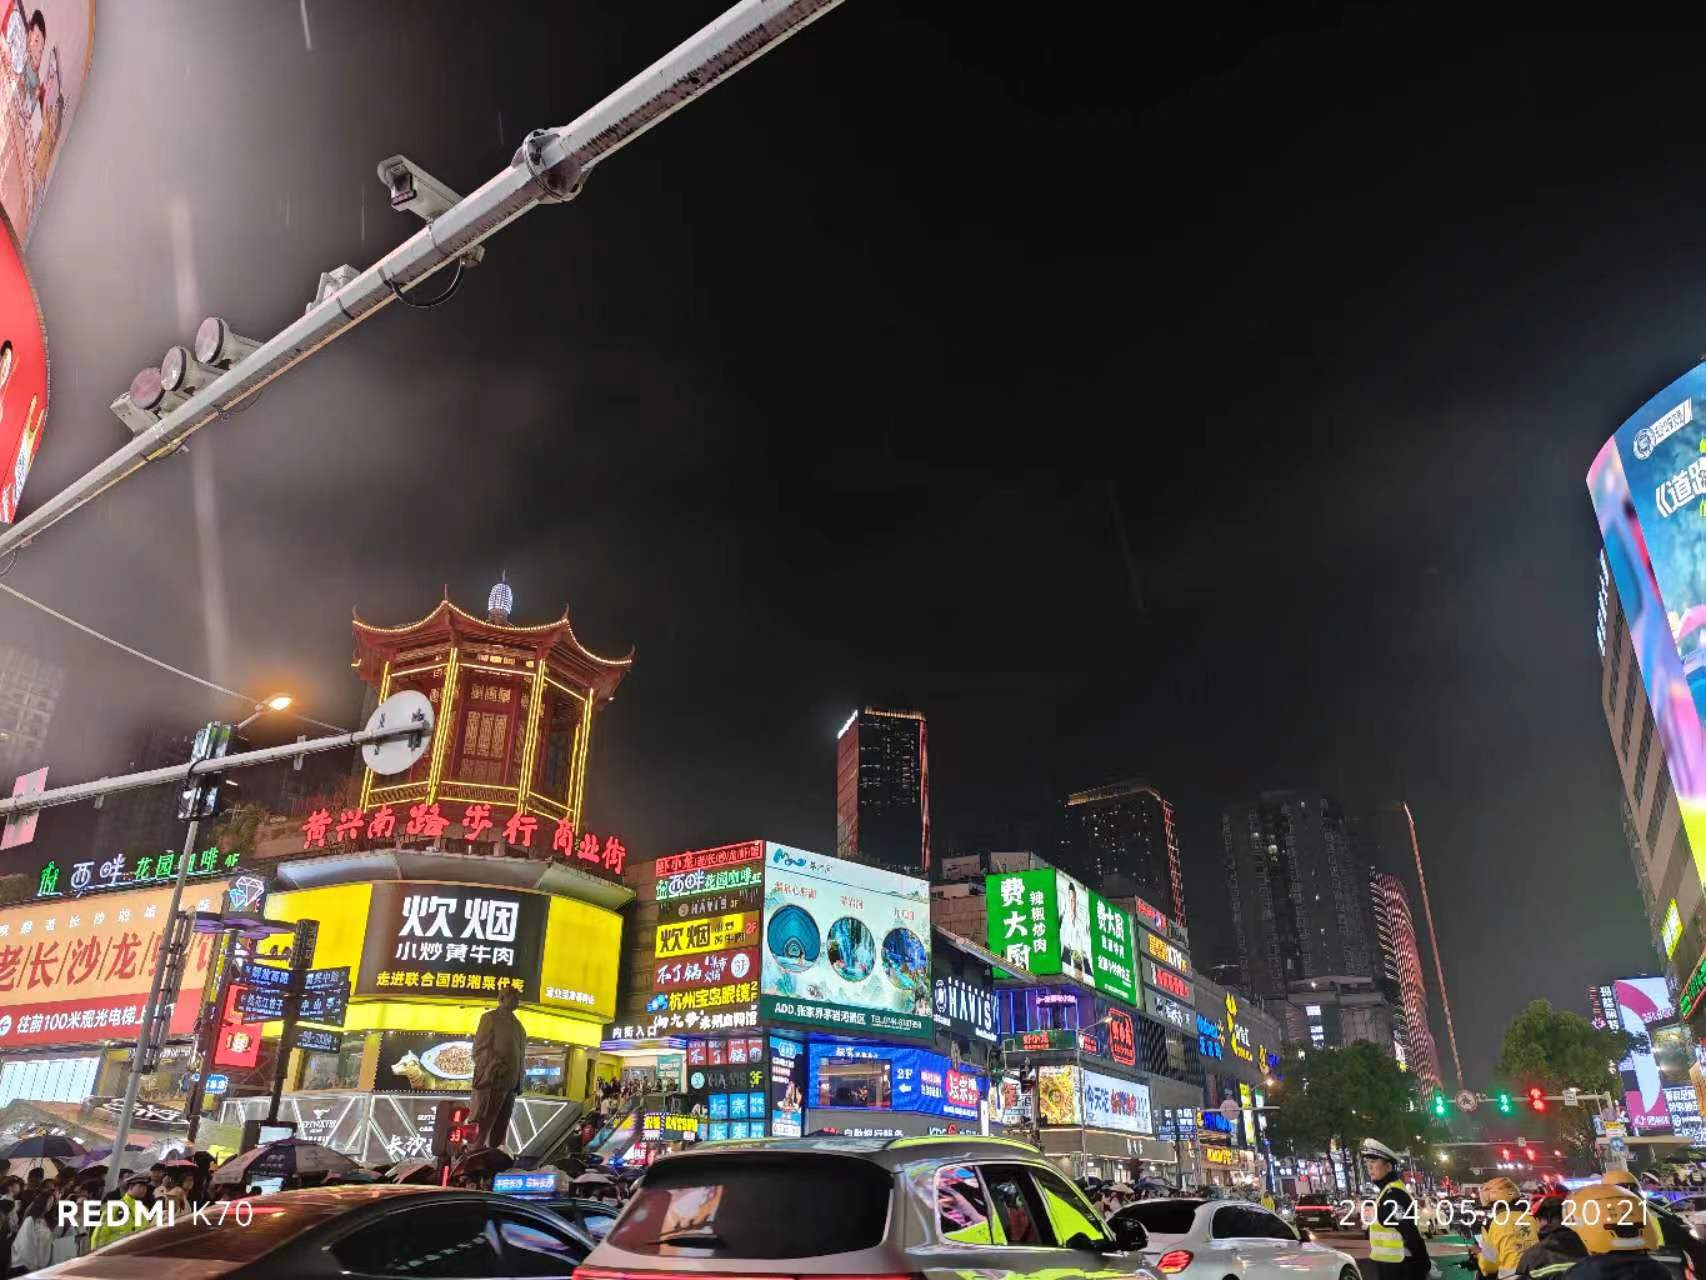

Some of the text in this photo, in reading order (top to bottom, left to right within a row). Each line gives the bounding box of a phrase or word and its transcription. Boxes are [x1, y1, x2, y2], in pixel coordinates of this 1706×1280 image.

[302, 802, 626, 874] 黄兴南路步行商业街
[399, 896, 519, 942] 炊烟
[1001, 877, 1030, 971] 费大厨
[395, 942, 514, 966] 小炒黄牛肉
[376, 971, 525, 993] 走进联合国的湘菜代表
[669, 984, 750, 1011] 杭州宝岛眼镜
[896, 1068, 913, 1080] 2F
